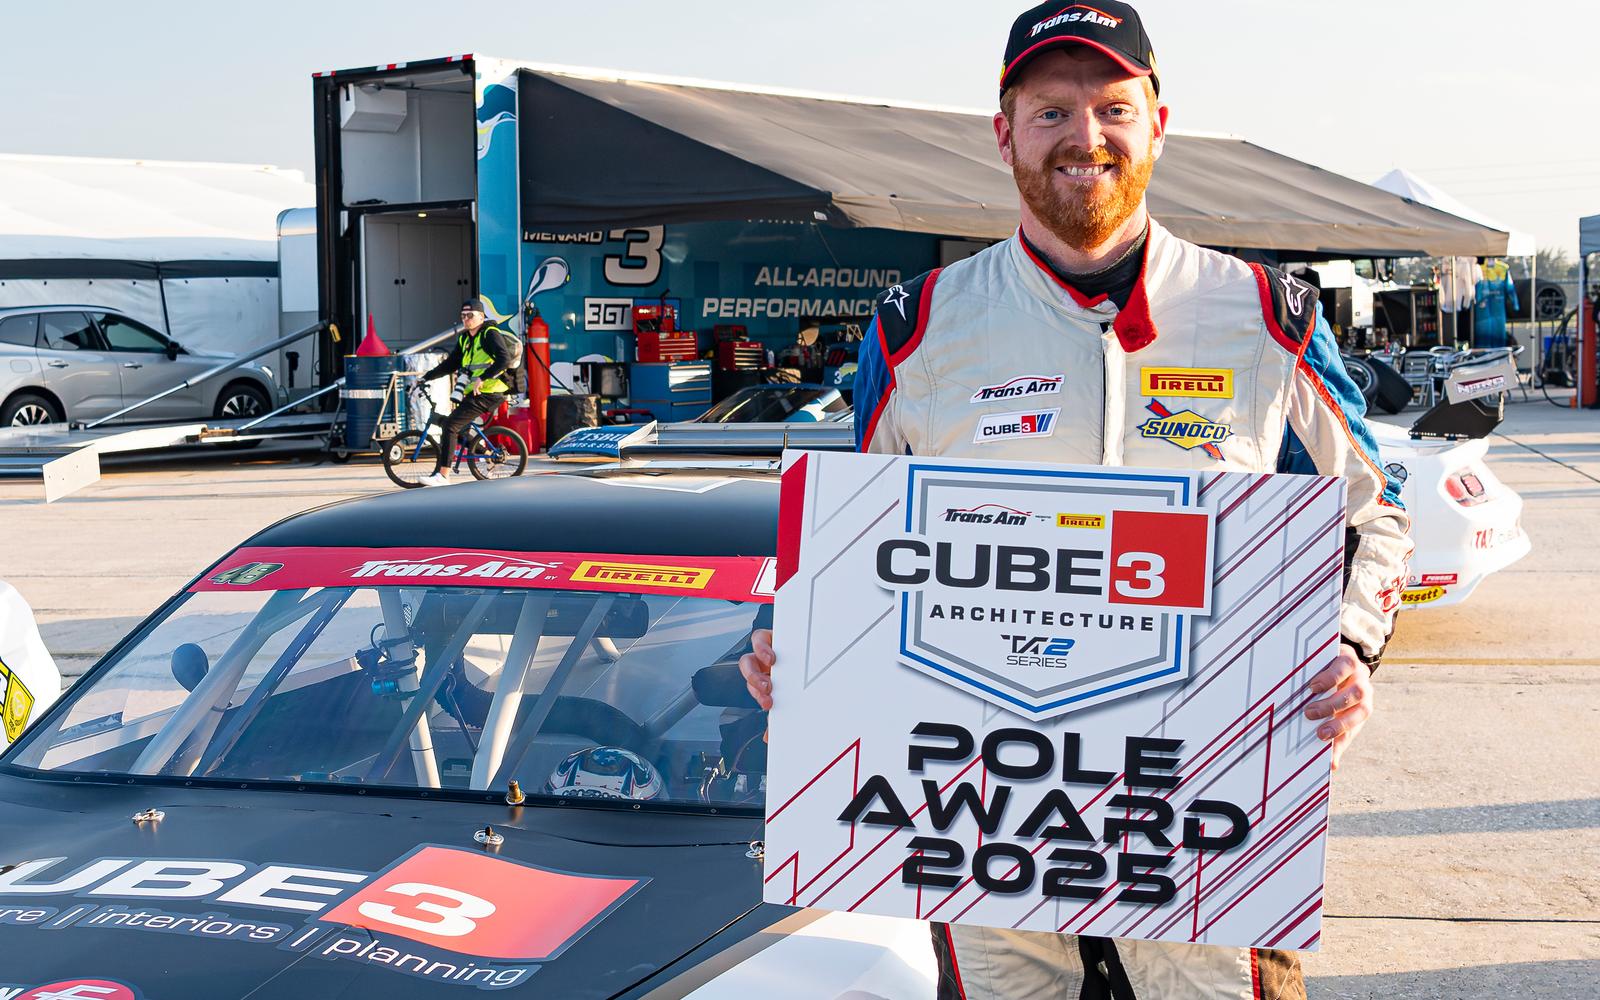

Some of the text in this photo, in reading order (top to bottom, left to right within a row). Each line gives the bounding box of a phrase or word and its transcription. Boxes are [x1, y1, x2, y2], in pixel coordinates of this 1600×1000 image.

[1030, 11, 1118, 38] Trans Am
[604, 224, 665, 285] 3
[754, 266, 901, 289] ALL-AROUND
[980, 381, 1058, 400] Trans Am
[1149, 373, 1225, 393] PIRELLI
[1145, 421, 1227, 440] SUNOCO
[944, 508, 992, 524] Trans
[993, 511, 1027, 526] Am
[1060, 515, 1102, 527] PIRELLI
[350, 560, 468, 578] Trans
[461, 560, 546, 580] Am
[583, 565, 701, 585] PIRELLI
[1400, 588, 1438, 602] ossett
[929, 604, 1155, 632] ARCHITECTURE
[1000, 634, 1076, 657] TA2
[1006, 655, 1068, 669] SERIES
[908, 721, 1186, 789] POLE
[836, 774, 1251, 850] AWARD
[902, 835, 1178, 904] 2025
[0, 908, 528, 986] re interiors planning
